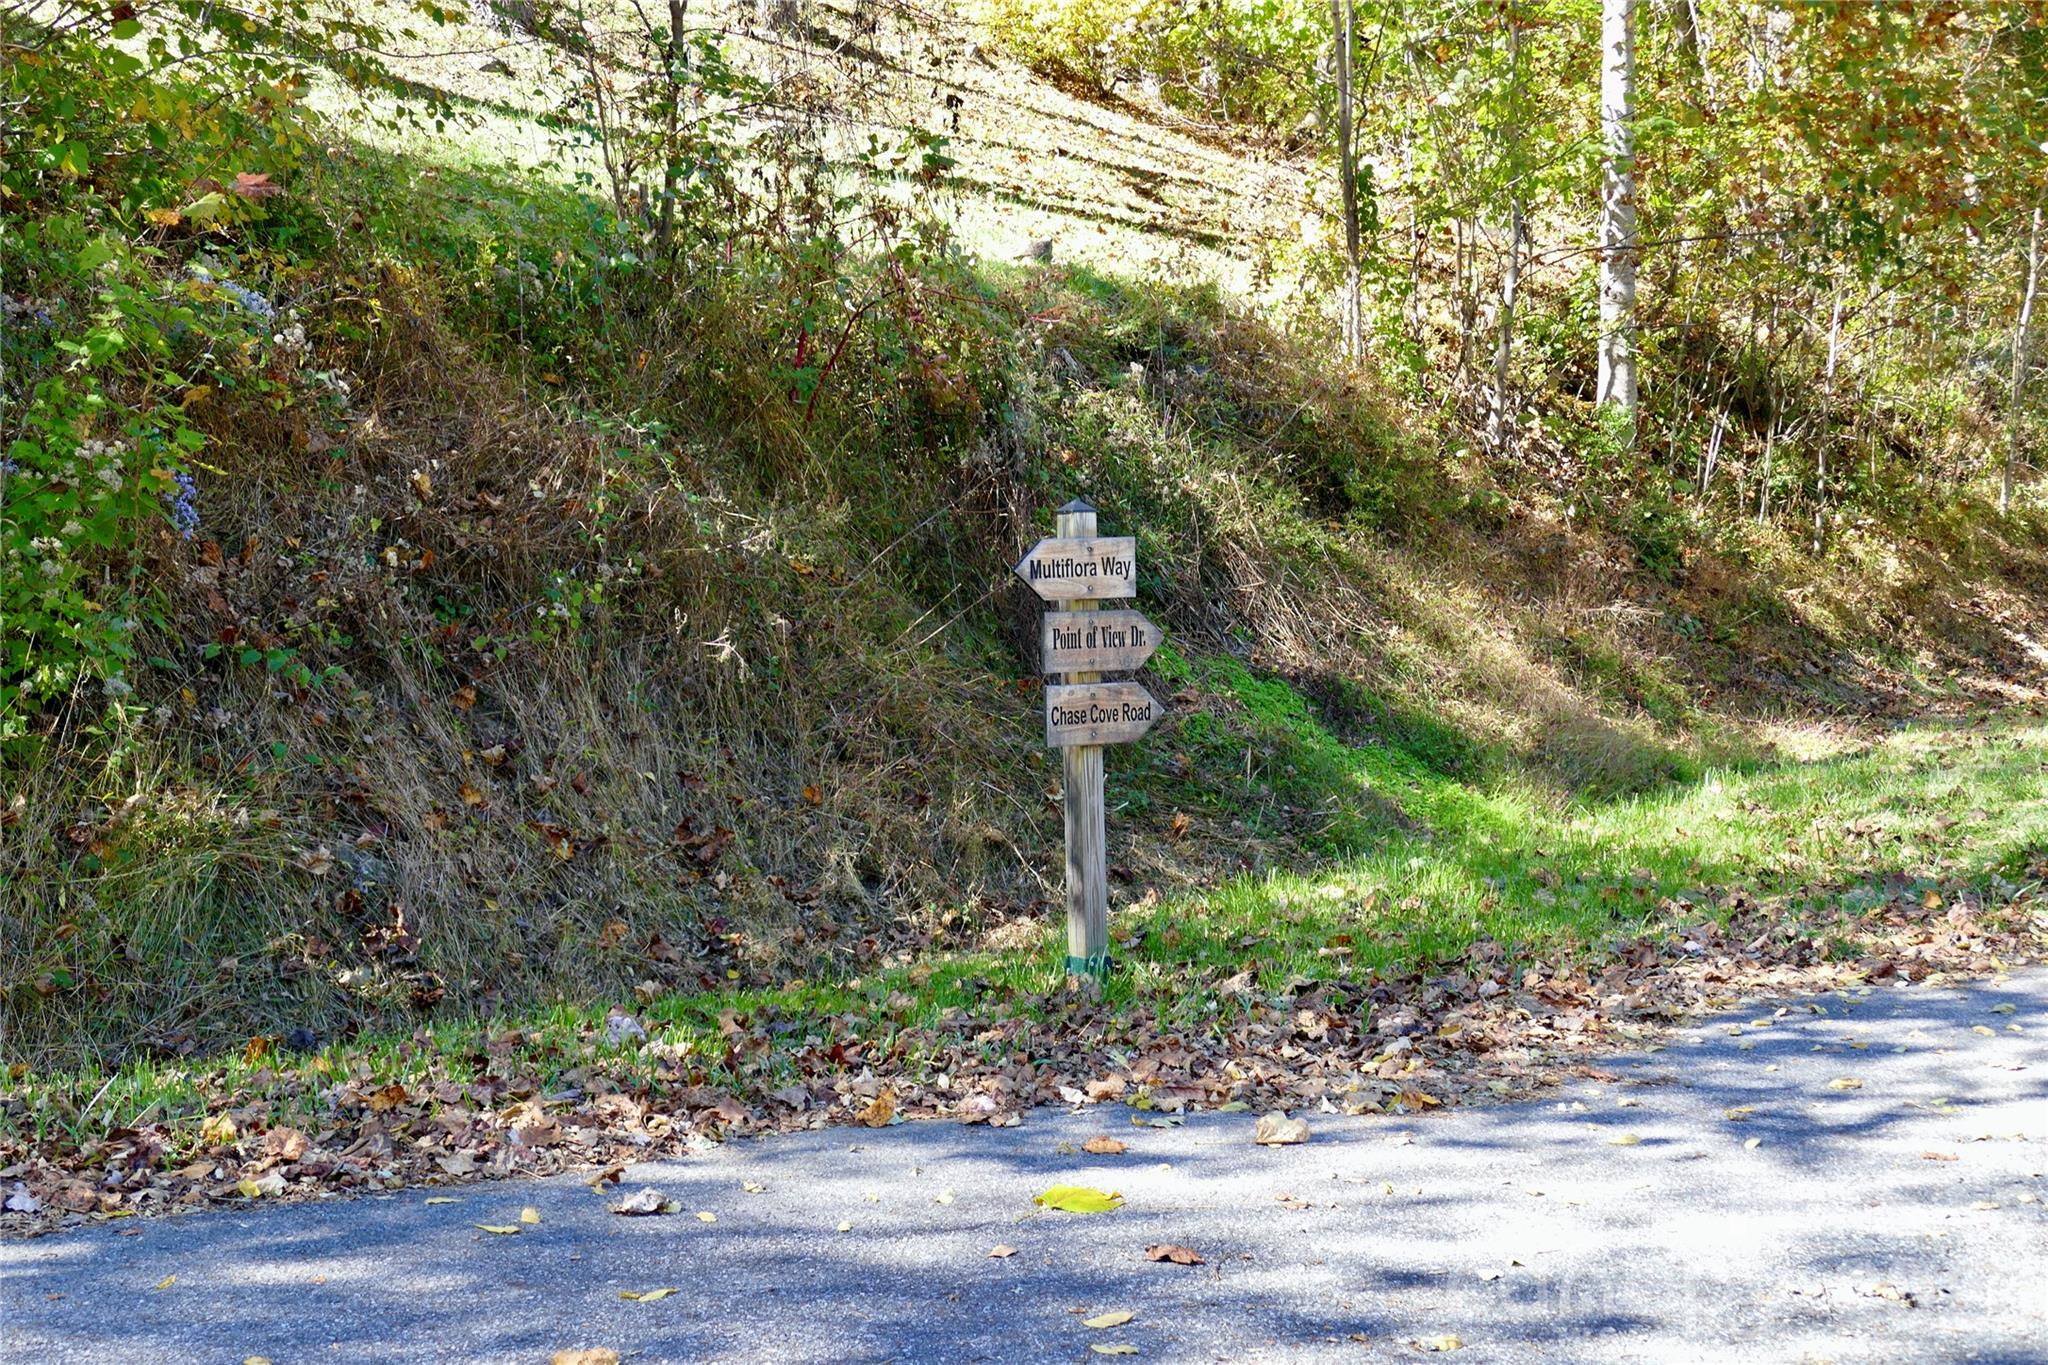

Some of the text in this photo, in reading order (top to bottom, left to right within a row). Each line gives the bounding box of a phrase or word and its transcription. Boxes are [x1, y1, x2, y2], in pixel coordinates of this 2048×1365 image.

[1029, 556, 1131, 580] Multiflora Way
[1052, 624, 1146, 650] Point of View Dr.
[1051, 702, 1151, 726] Chase Cove Road
